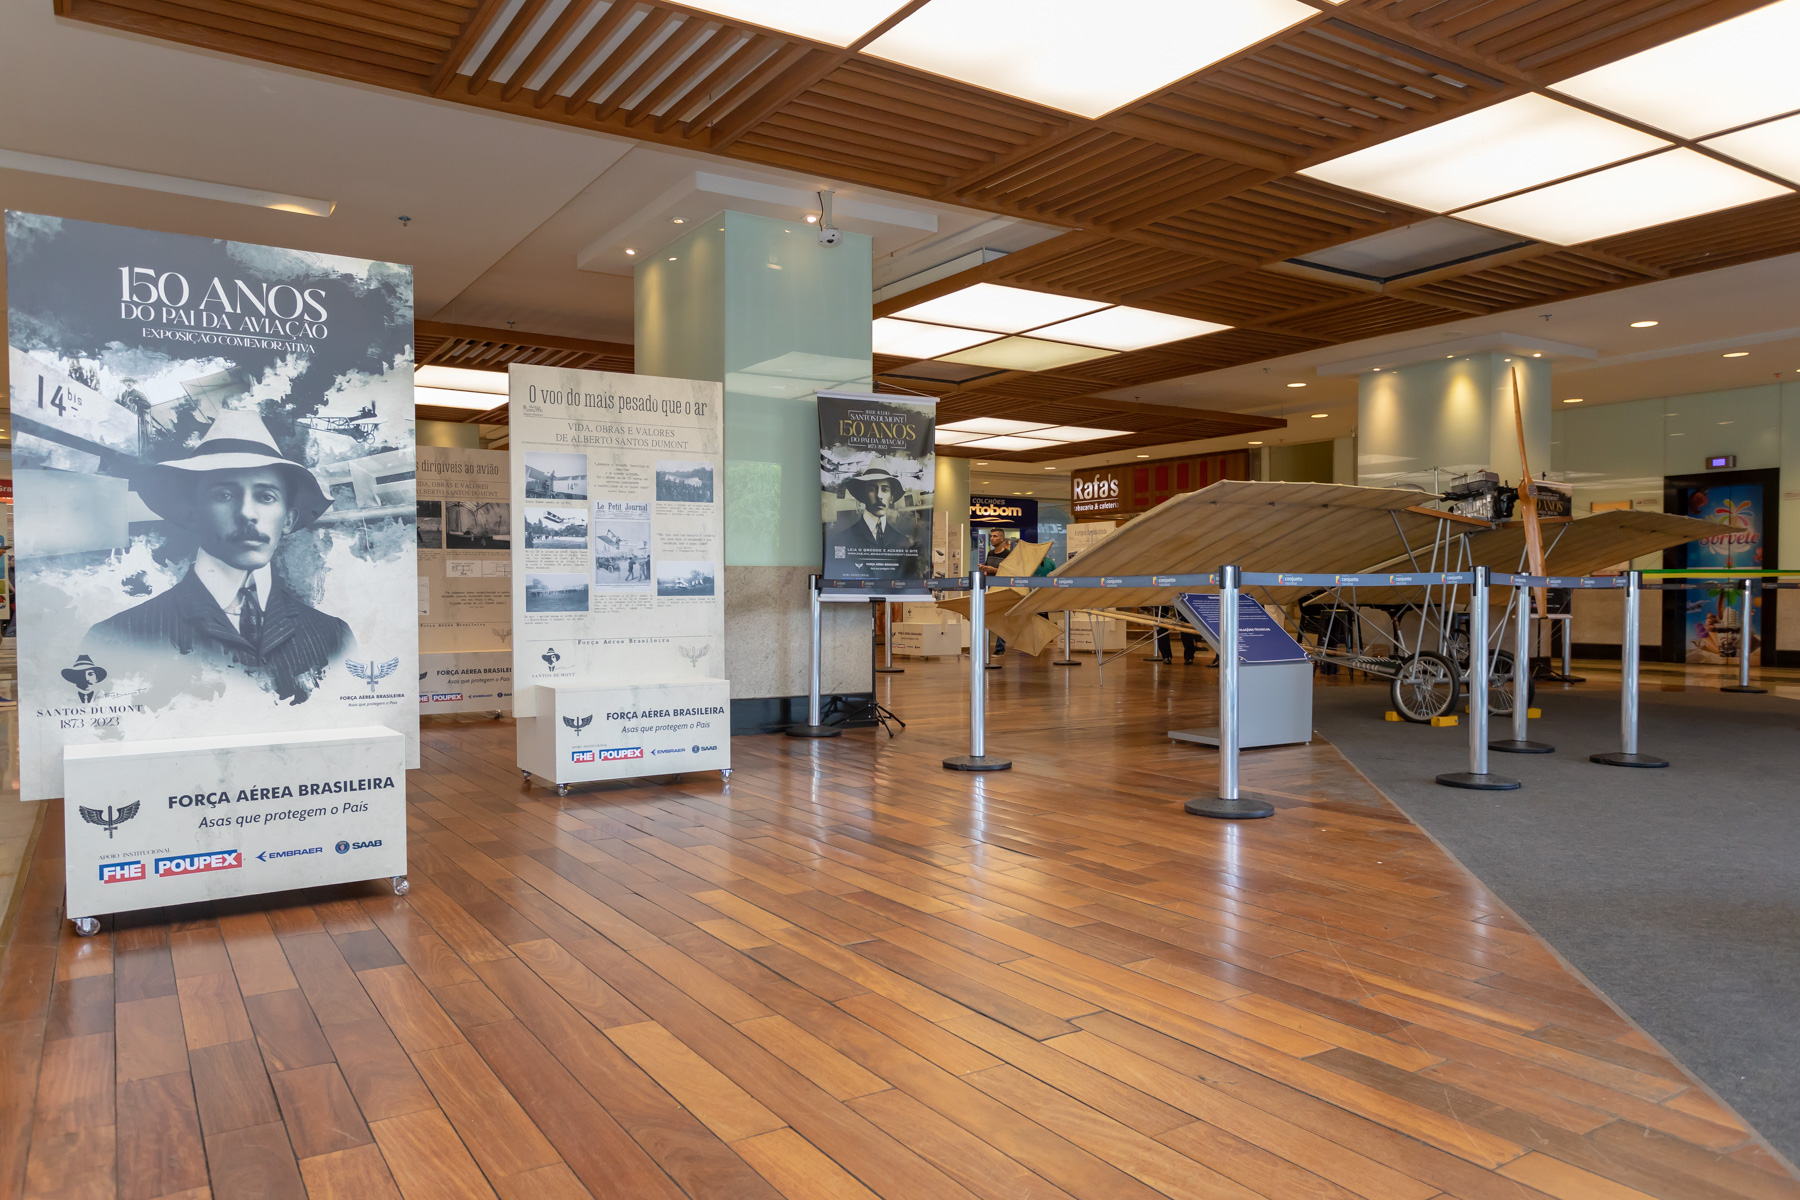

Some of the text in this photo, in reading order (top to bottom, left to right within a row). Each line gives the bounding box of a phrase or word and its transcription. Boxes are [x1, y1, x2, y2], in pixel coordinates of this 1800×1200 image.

[118, 266, 328, 322] 150 ANOS
[120, 302, 328, 340] DO PAI DA AVIAÇÃO
[218, 336, 316, 354] COMEMORATIVA
[529, 384, 708, 416] O voo do mais pesado que o ar
[596, 424, 625, 435] OBRAS
[628, 426, 633, 435] E
[636, 427, 675, 438] VALORES
[840, 420, 916, 440] 150 ANOS
[555, 434, 688, 450] DE ALBERTO SANTOS DUMONT
[421, 460, 462, 475] dirigíveis
[464, 464, 474, 474] ao
[476, 464, 499, 475] avião
[1074, 473, 1119, 500] Rafa's
[597, 502, 604, 510] Le
[608, 502, 622, 511] Petit
[625, 503, 648, 511] Journal
[970, 504, 1022, 516] rtobom
[36, 704, 143, 718] SANTOS DUMONT
[606, 706, 725, 721] FORÇA AÉREA BRASILEIRA
[60, 716, 120, 729] 1873 2023
[621, 725, 638, 734] Asas
[640, 725, 654, 734] que
[655, 722, 688, 733] protegem
[574, 749, 641, 761] FHE POUPEX
[168, 777, 395, 809] FORÇA AÉREA BRASILEIRA
[198, 801, 368, 828] Asas que protegem o País
[352, 840, 382, 850] SAAB
[123, 848, 172, 858] INSTITUCIONAL
[269, 847, 323, 859] EMBRAER
[103, 852, 238, 880] FHE POUPEX
